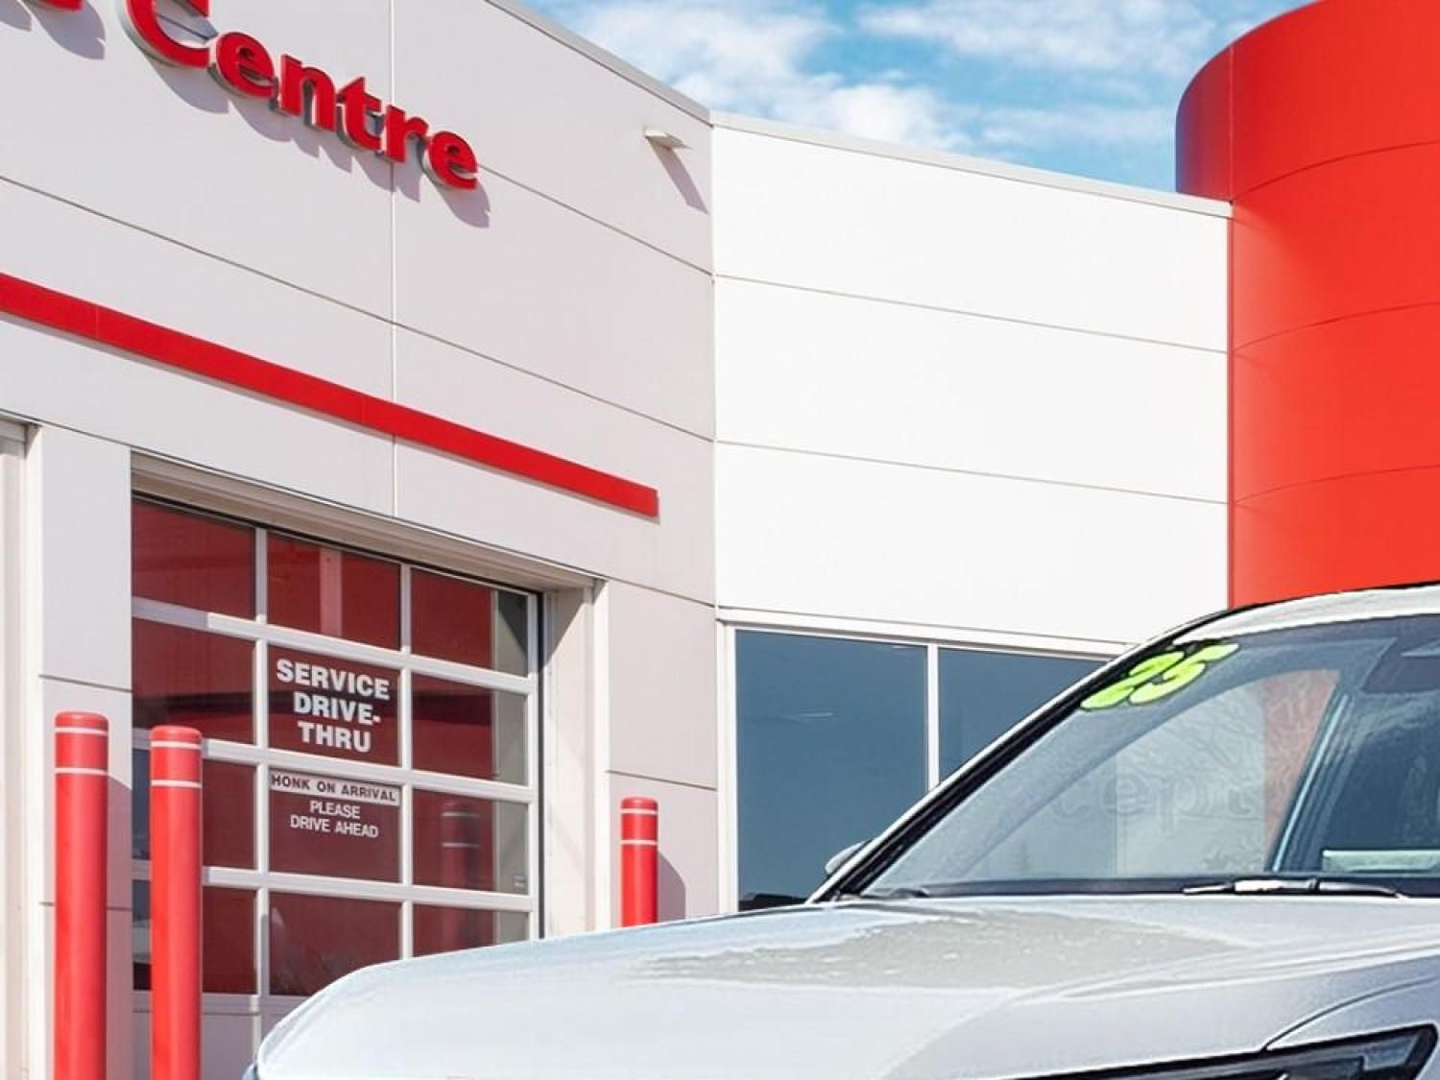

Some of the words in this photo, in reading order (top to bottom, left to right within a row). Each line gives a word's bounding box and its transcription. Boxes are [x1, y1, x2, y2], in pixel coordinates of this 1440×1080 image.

[124, 0, 478, 190] Centre
[276, 658, 390, 700] SERVICE
[293, 691, 381, 726] DRIVE-
[298, 721, 372, 753] THRU
[271, 775, 311, 790] HONK
[316, 780, 336, 794] ON
[341, 784, 397, 802] ARRIVAL
[310, 800, 361, 819] PLEASE
[290, 814, 330, 833] DRIVE
[335, 821, 379, 838] AHEAD
